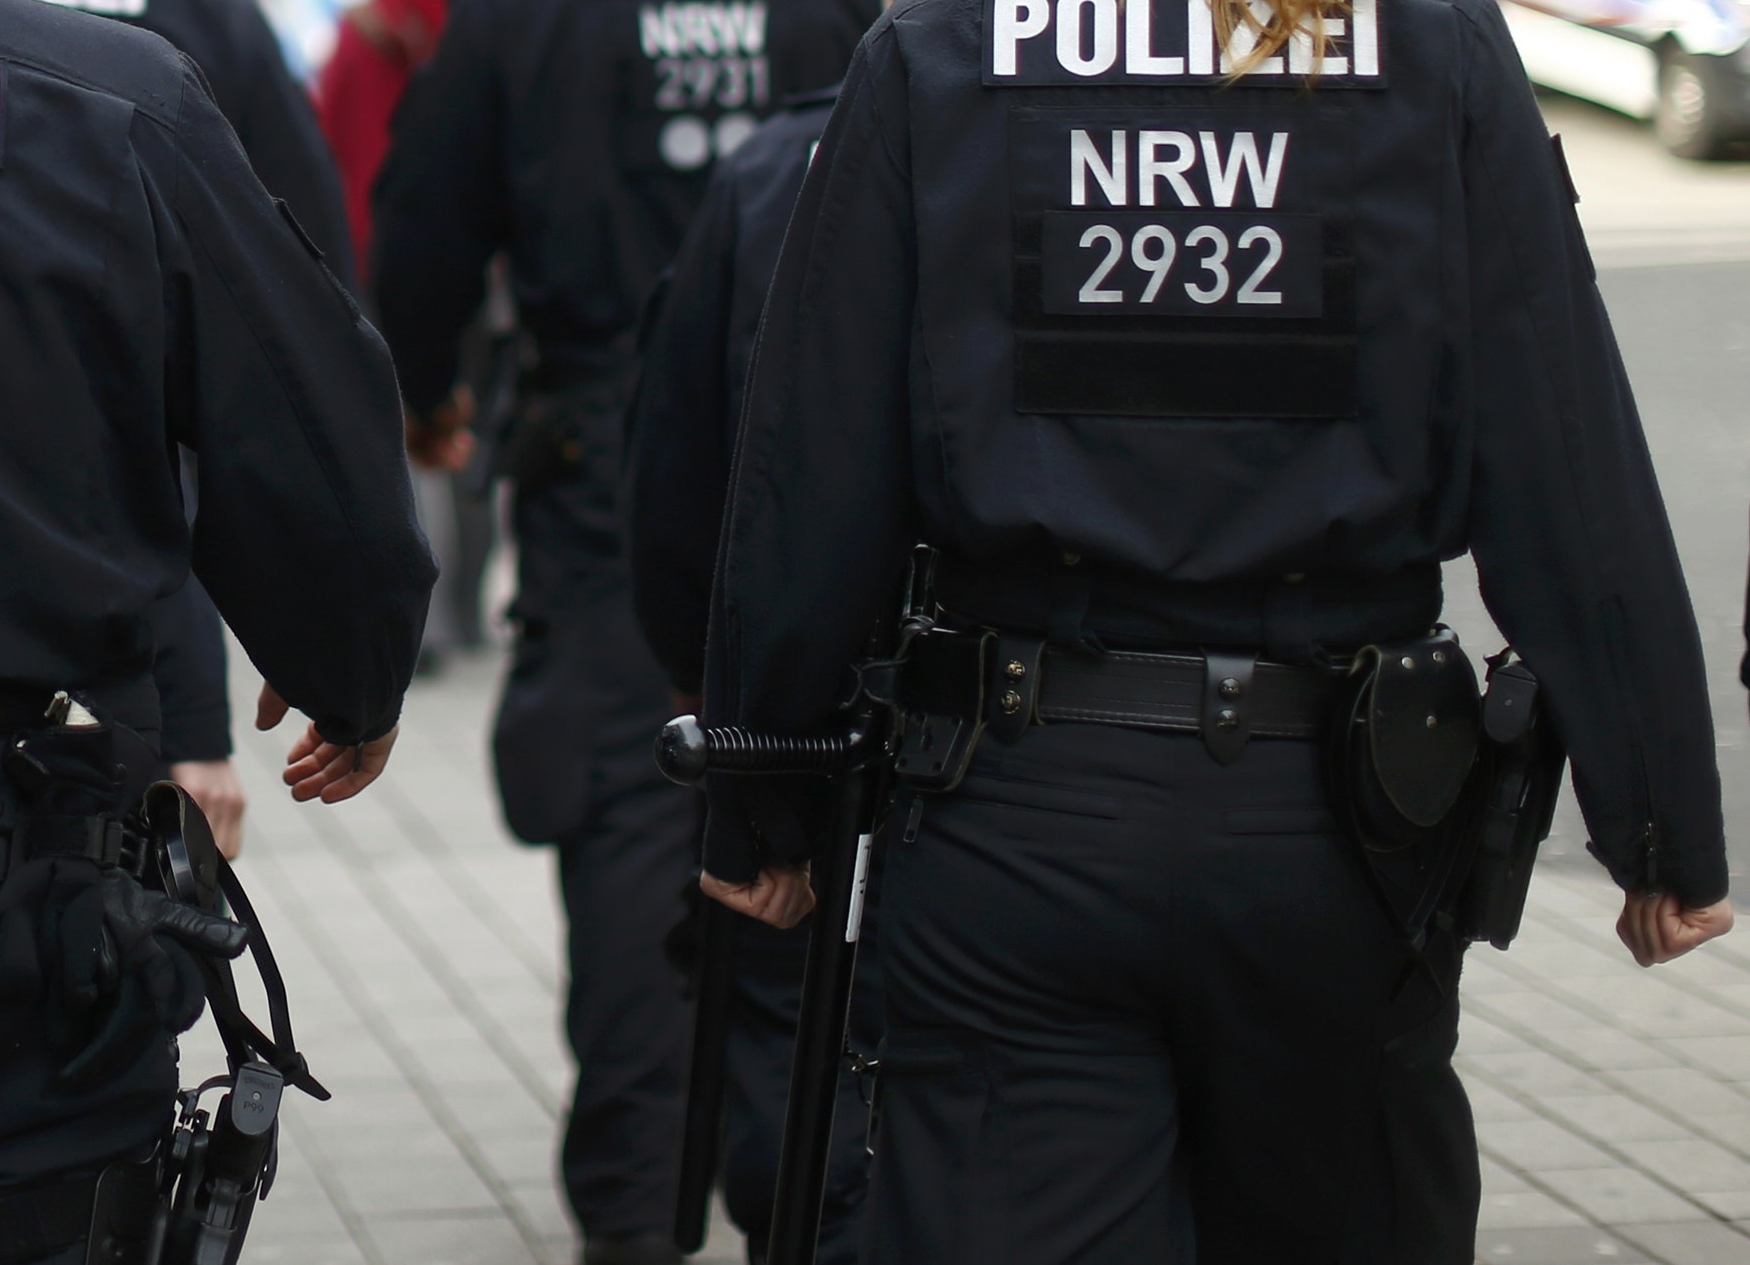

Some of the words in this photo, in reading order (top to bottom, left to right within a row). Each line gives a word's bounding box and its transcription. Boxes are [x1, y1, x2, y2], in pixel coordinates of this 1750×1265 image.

[654, 56, 770, 109] 2931
[1069, 128, 1289, 209] NRW
[1078, 224, 1283, 305] 2932
[242, 1100, 265, 1113] P99
